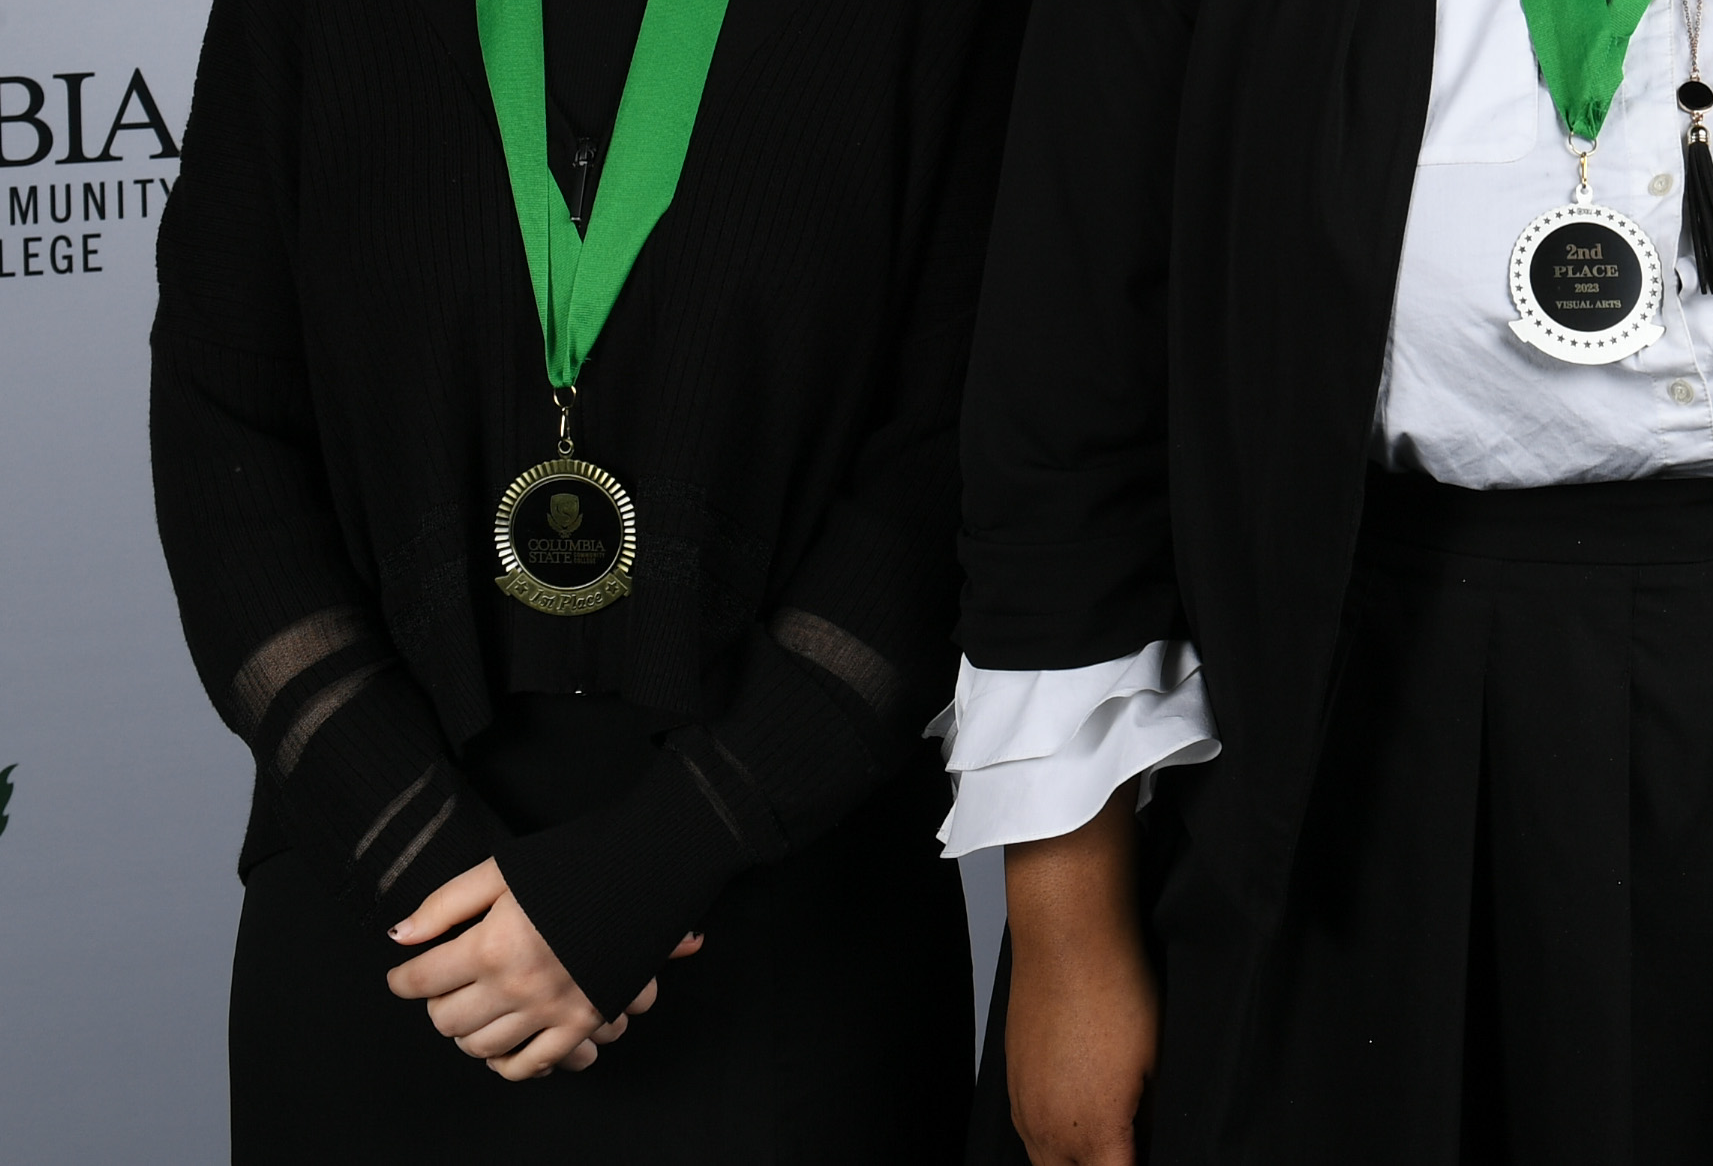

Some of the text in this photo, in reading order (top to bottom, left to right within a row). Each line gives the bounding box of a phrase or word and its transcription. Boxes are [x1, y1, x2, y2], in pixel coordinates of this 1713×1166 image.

[1565, 243, 1602, 259] 2nd
[1553, 264, 1618, 277] PLACE
[1574, 283, 1599, 292] 2023
[1555, 299, 1621, 308] VISUAL ARTS
[528, 538, 605, 551] COLUMBIA
[528, 551, 571, 563] STATE
[529, 587, 603, 612] 1st Place
